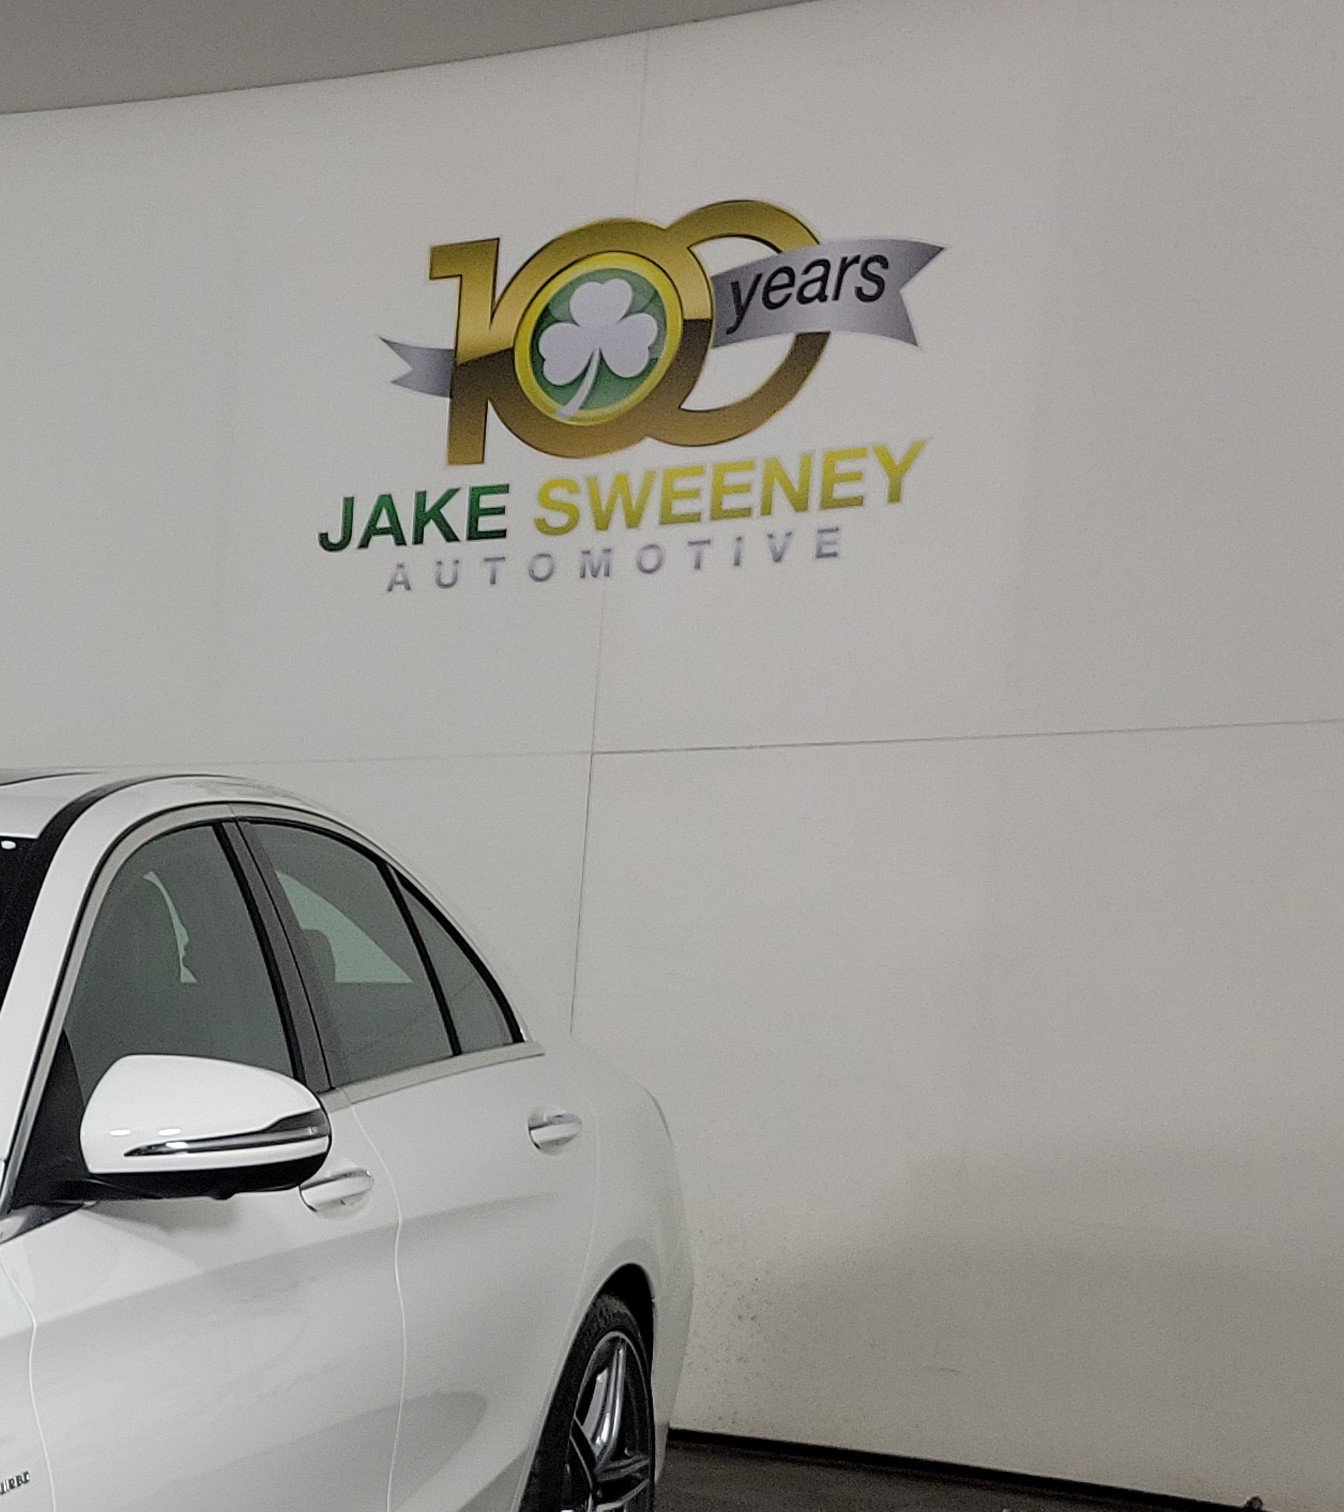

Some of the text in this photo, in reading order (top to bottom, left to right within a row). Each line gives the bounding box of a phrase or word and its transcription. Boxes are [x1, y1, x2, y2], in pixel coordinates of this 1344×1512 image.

[429, 200, 831, 465] 100
[726, 251, 890, 335] years
[318, 439, 928, 552] JAKE SWEENEY
[386, 526, 841, 593] AUTOMOTIVE
